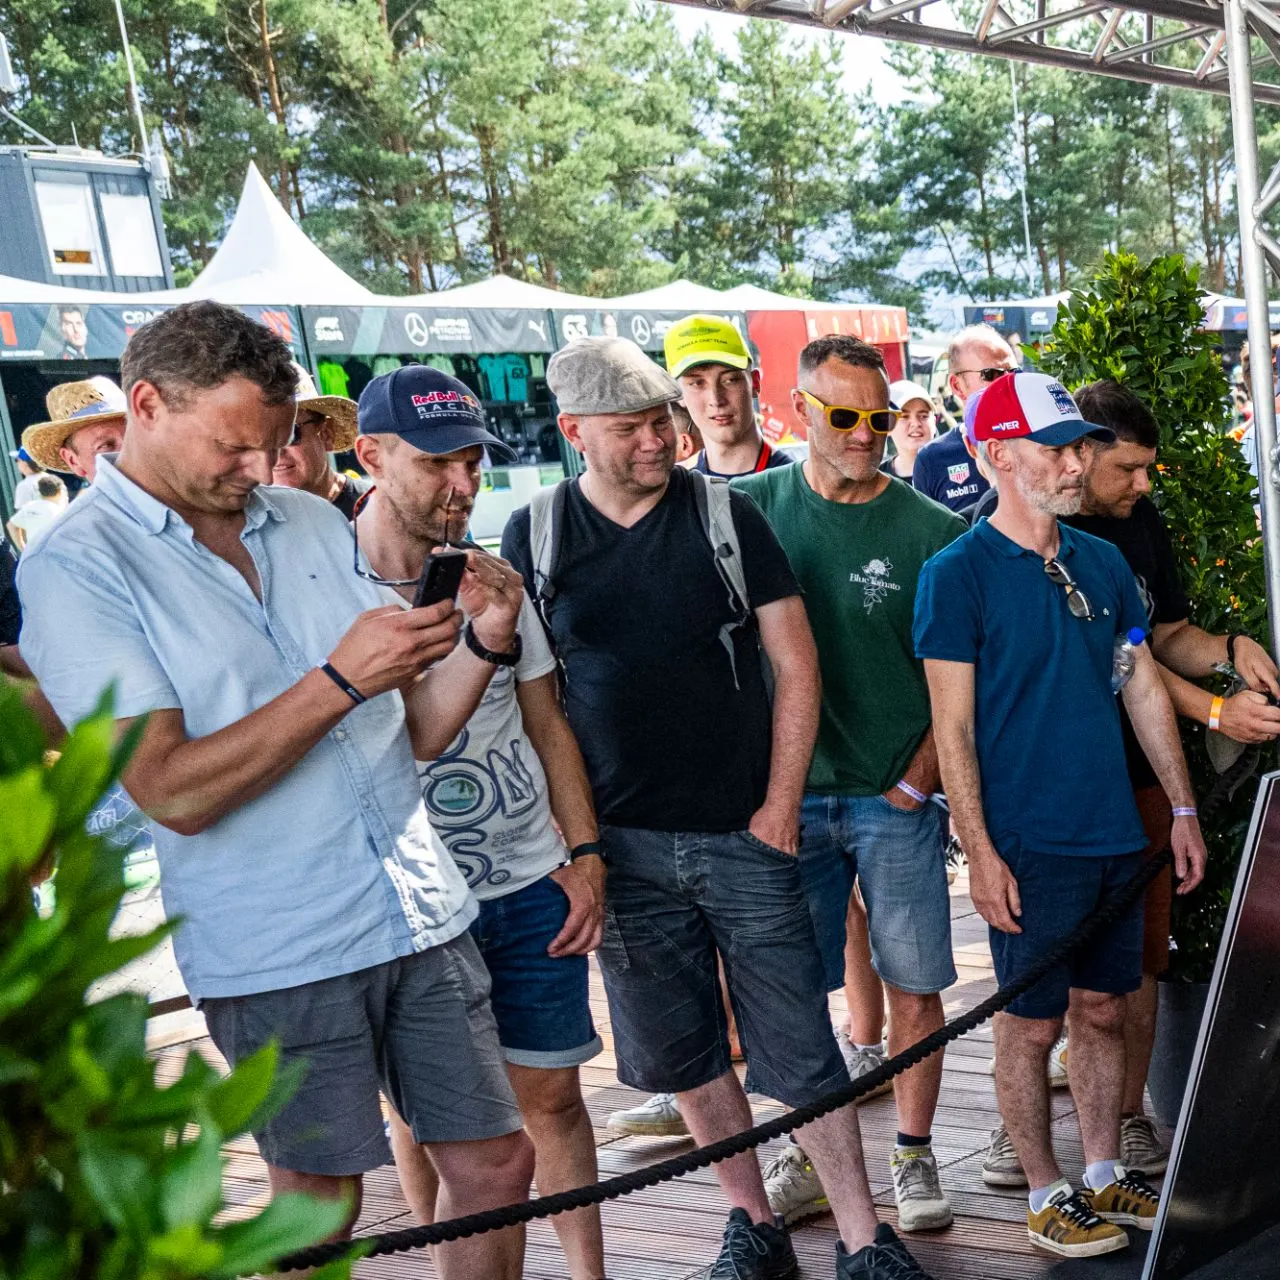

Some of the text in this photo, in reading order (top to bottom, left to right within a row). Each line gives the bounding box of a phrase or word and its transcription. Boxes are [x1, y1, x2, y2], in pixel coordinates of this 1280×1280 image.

[412, 391, 457, 406] Red Bull
[999, 420, 1019, 431] VER
[949, 465, 970, 475] TAG
[947, 486, 969, 499] Mobil
[849, 572, 901, 591] Blue Tomato
